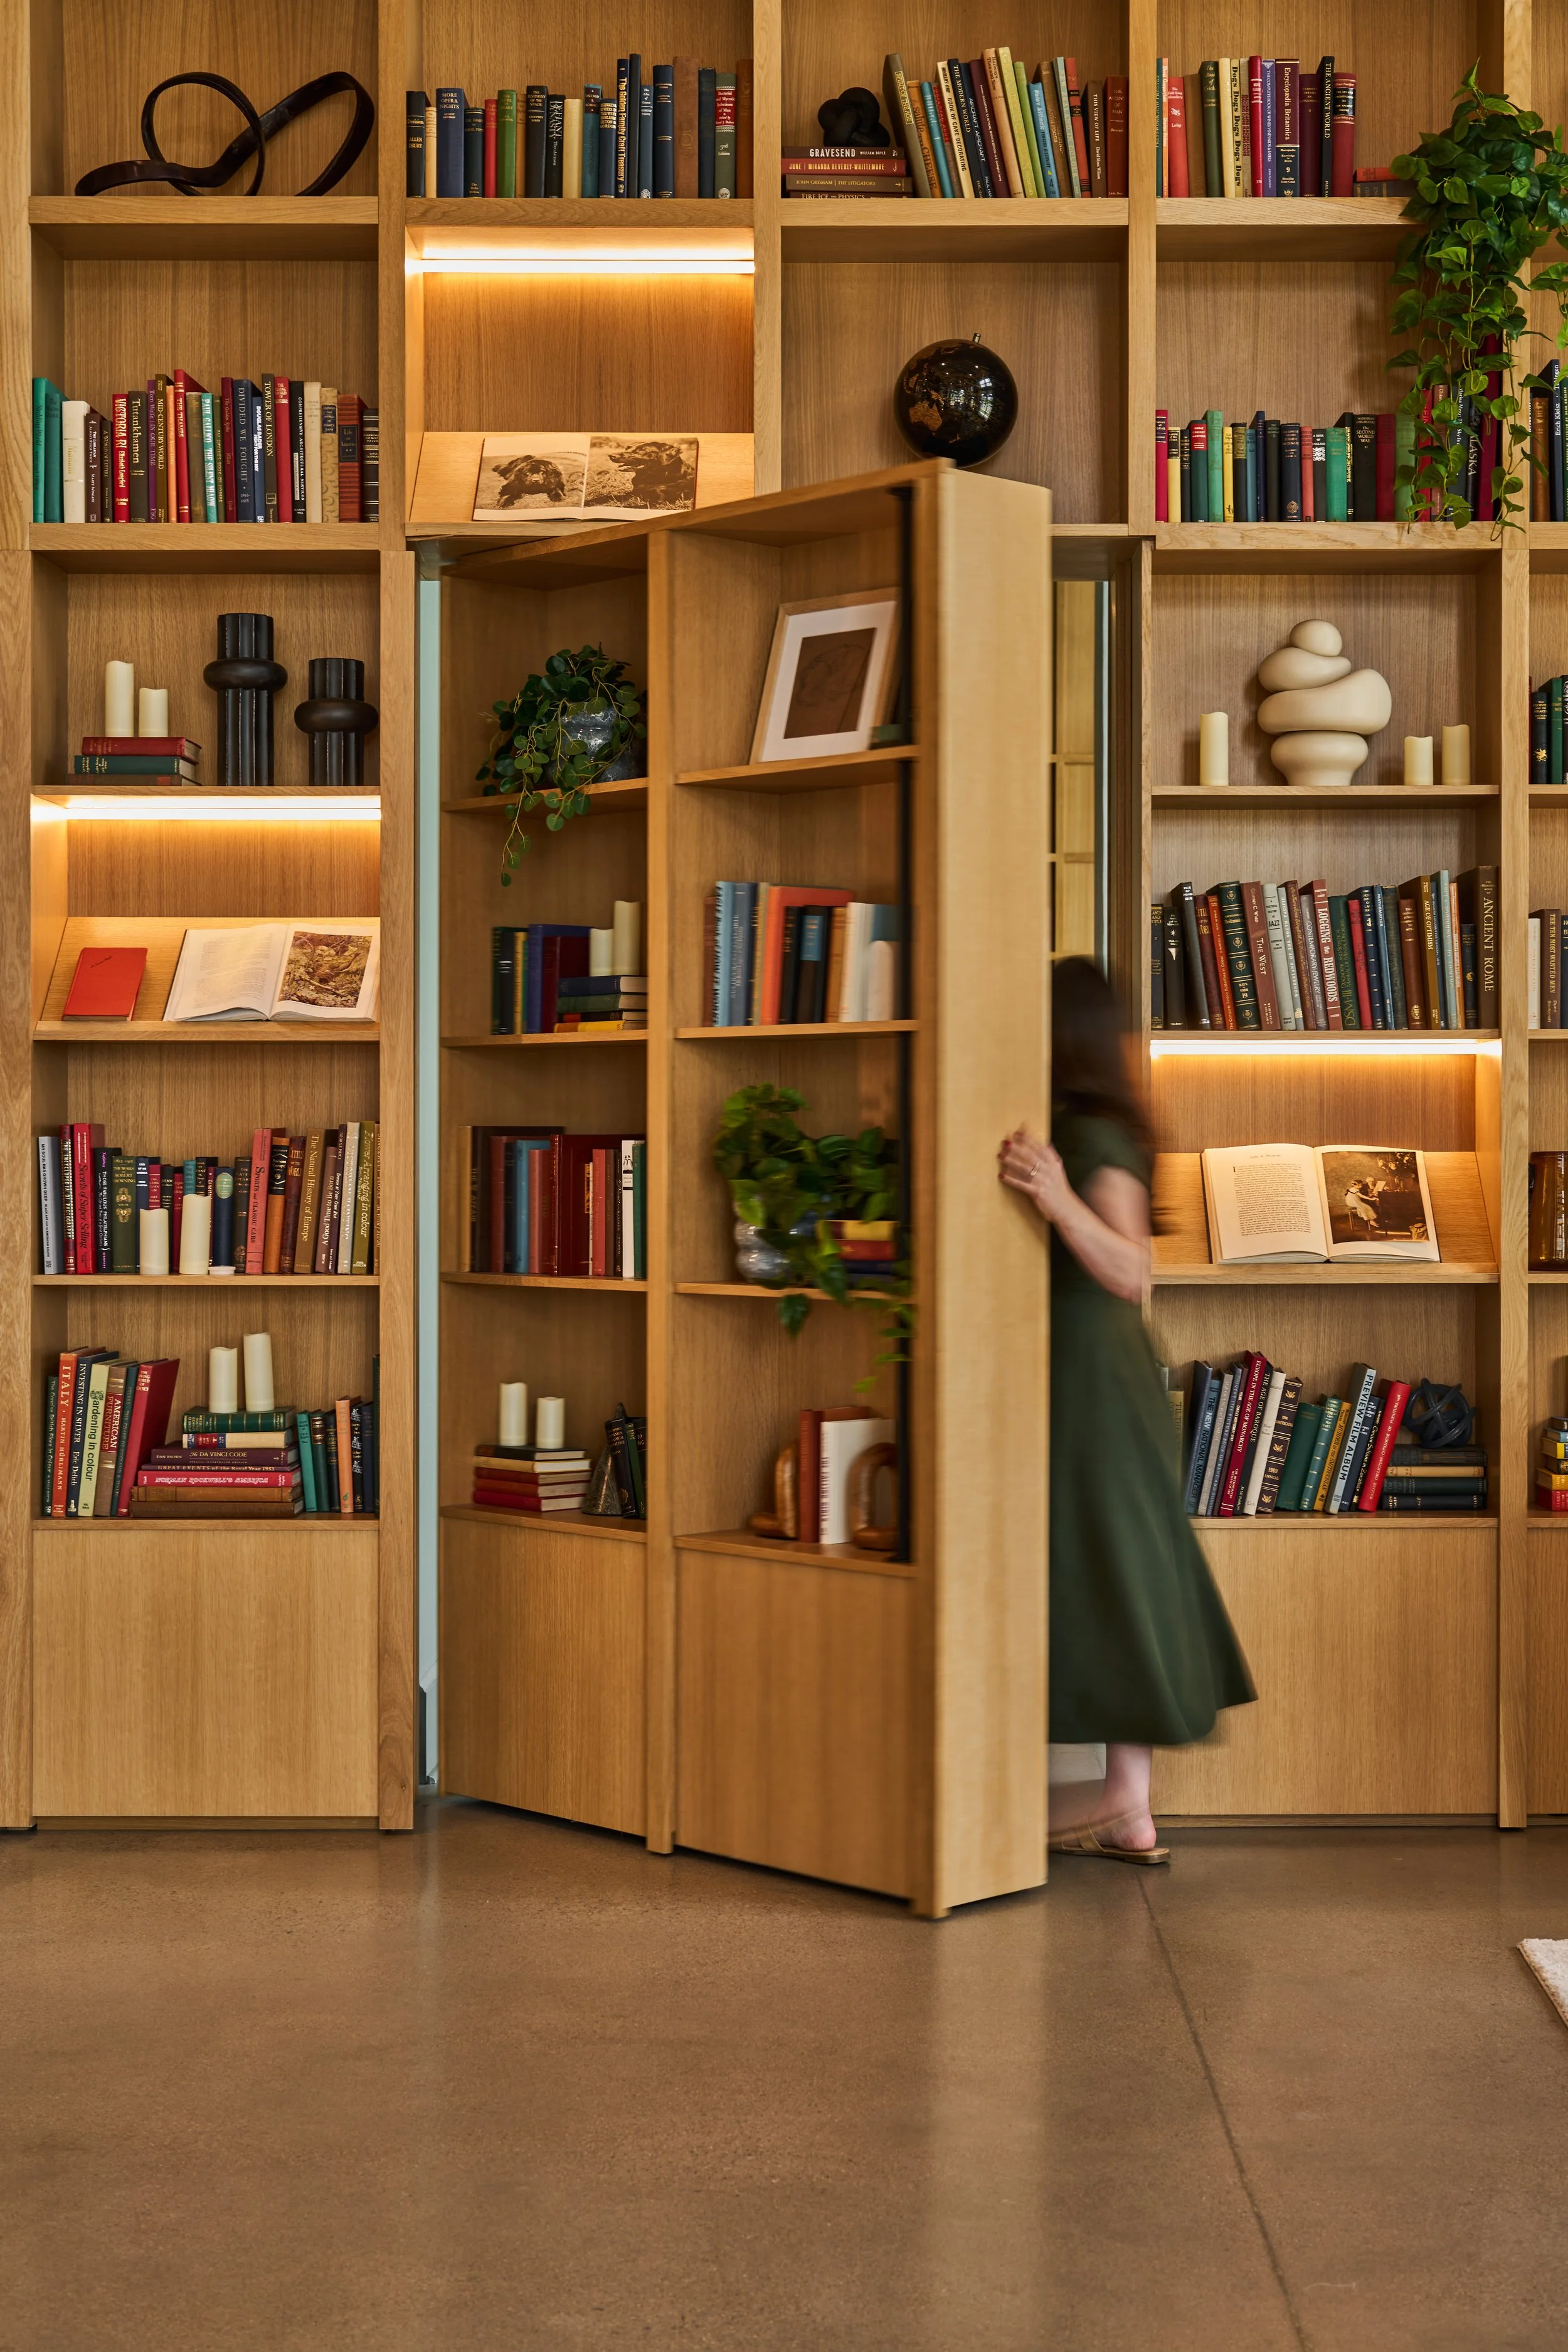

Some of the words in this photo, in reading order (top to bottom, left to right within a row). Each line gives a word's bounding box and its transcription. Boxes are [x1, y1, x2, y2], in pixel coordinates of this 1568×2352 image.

[618, 77, 627, 90] The
[1231, 66, 1239, 87] Dogs
[1283, 66, 1291, 106] Encyclopædia
[617, 90, 627, 112] Golden
[946, 97, 955, 112] BOOK
[955, 79, 966, 108] MODERN
[961, 109, 971, 133] WORLD
[1231, 90, 1240, 112] Dogs
[617, 112, 627, 134] Family
[950, 112, 956, 121] OF
[1232, 115, 1241, 137] Dogs
[951, 121, 960, 136] CAKE
[617, 135, 626, 152] Craft
[810, 149, 856, 157] GRAVESEND
[955, 137, 967, 171] DECORATING
[1233, 139, 1241, 161] Dogs
[617, 152, 626, 181] Treasury
[1234, 164, 1242, 186] Dogs
[238, 387, 246, 425] DIVIDED
[263, 381, 272, 410] TOWER
[114, 398, 127, 437] VICTORIA
[201, 398, 211, 416] PAUL
[264, 411, 272, 422] OF
[131, 398, 141, 464] Tutankhamen
[202, 417, 213, 443] GALLICO
[239, 428, 246, 442] WE
[265, 423, 273, 457] LONDON
[115, 438, 127, 448] RI
[203, 447, 214, 461] THE
[204, 462, 215, 484] SILENT
[239, 446, 247, 482] FOUGHT
[117, 470, 125, 487] Longford
[205, 485, 215, 507] MIAOW
[1317, 907, 1331, 943] LOGGING
[1424, 912, 1431, 920] OF
[1483, 896, 1494, 951] ANCIENT
[1255, 937, 1264, 953] THE
[1425, 920, 1434, 950] OPTIMISM
[1258, 954, 1267, 975] WEST
[1483, 956, 1494, 992] ROME
[1322, 956, 1338, 1002] REDWOODS
[310, 1135, 320, 1149] The
[363, 1130, 374, 1159] Flower
[307, 1150, 318, 1177] Natural
[78, 1163, 88, 1190] Secrets
[360, 1159, 373, 1202] Arranging
[78, 1190, 88, 1199] of
[303, 1178, 315, 1205] History
[326, 1190, 333, 1199] Be
[78, 1199, 88, 1221] Super
[304, 1205, 313, 1214] of
[324, 1206, 332, 1223] Time
[361, 1203, 370, 1211] in
[79, 1222, 88, 1249] Selling
[300, 1215, 312, 1242] Europe
[322, 1222, 330, 1239] Good
[359, 1212, 370, 1237] colour
[1251, 1359, 1261, 1382] EUROPE
[1262, 1372, 1270, 1387] THE
[60, 1365, 72, 1407] ITALY
[76, 1363, 86, 1404] INVESTING
[1259, 1386, 1267, 1401] AGE
[1207, 1396, 1216, 1411] THE
[1247, 1389, 1255, 1401] THE
[1257, 1401, 1264, 1410] OF
[1355, 1374, 1374, 1419] PREVIEW
[75, 1406, 83, 1415] IN
[1243, 1412, 1250, 1421] OF
[1244, 1401, 1253, 1412] AGE
[73, 1417, 82, 1443] SILVER
[109, 1398, 122, 1448] AMERICAN
[1203, 1411, 1212, 1429] NEW
[1248, 1411, 1261, 1443] BAROQUE
[1236, 1421, 1248, 1453] MONARCHY
[1348, 1421, 1361, 1443] FILM
[1196, 1429, 1209, 1463] RATIONAL
[56, 1446, 65, 1490] HÜRLIMANN
[1338, 1444, 1354, 1481] ALBUM
[1190, 1463, 1203, 1498] MANAGER
